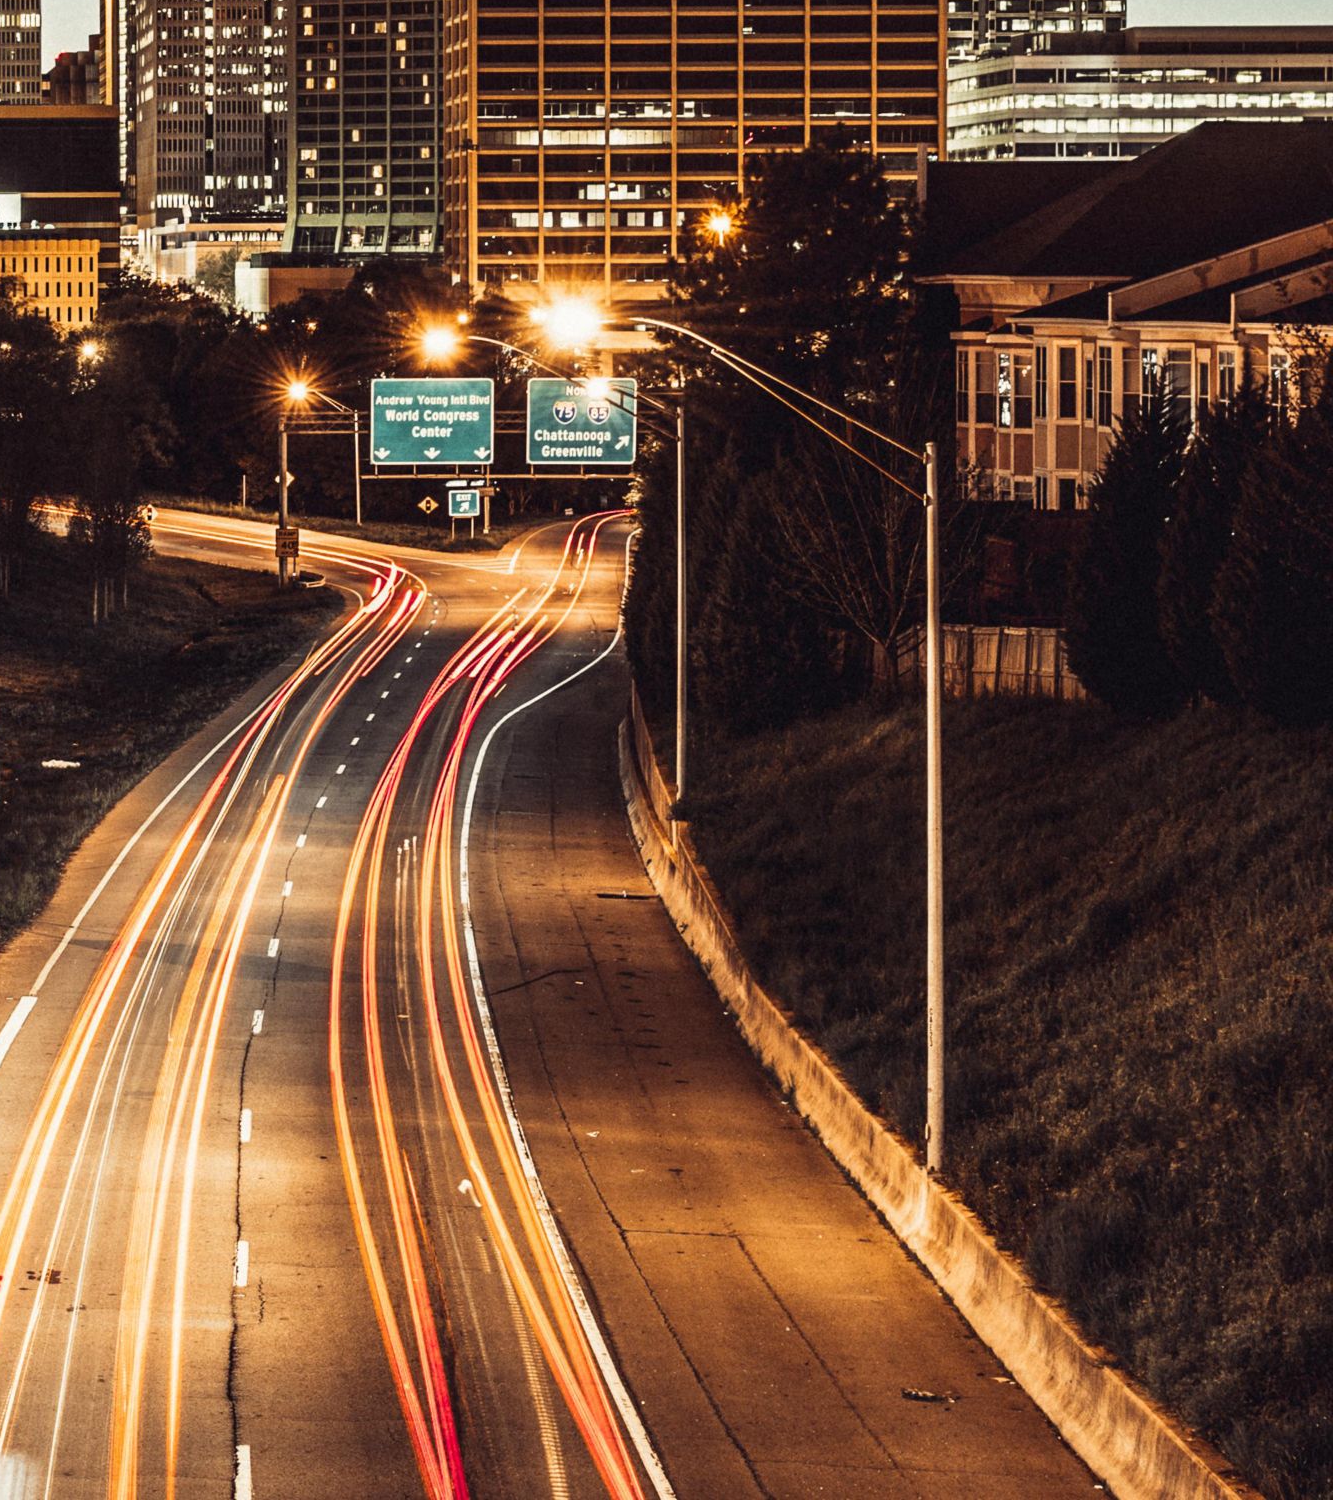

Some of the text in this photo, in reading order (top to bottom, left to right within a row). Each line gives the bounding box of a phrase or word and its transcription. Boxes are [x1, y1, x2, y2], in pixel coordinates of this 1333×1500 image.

[375, 395, 413, 405] Andrew
[417, 395, 449, 407] Young
[469, 395, 490, 405] Blvd
[385, 409, 480, 425] World Congress
[556, 408, 608, 419] 75 85
[412, 426, 453, 438] Center
[534, 429, 611, 444] Chattanooga
[541, 445, 603, 457] Greenville
[281, 541, 294, 550] 40
